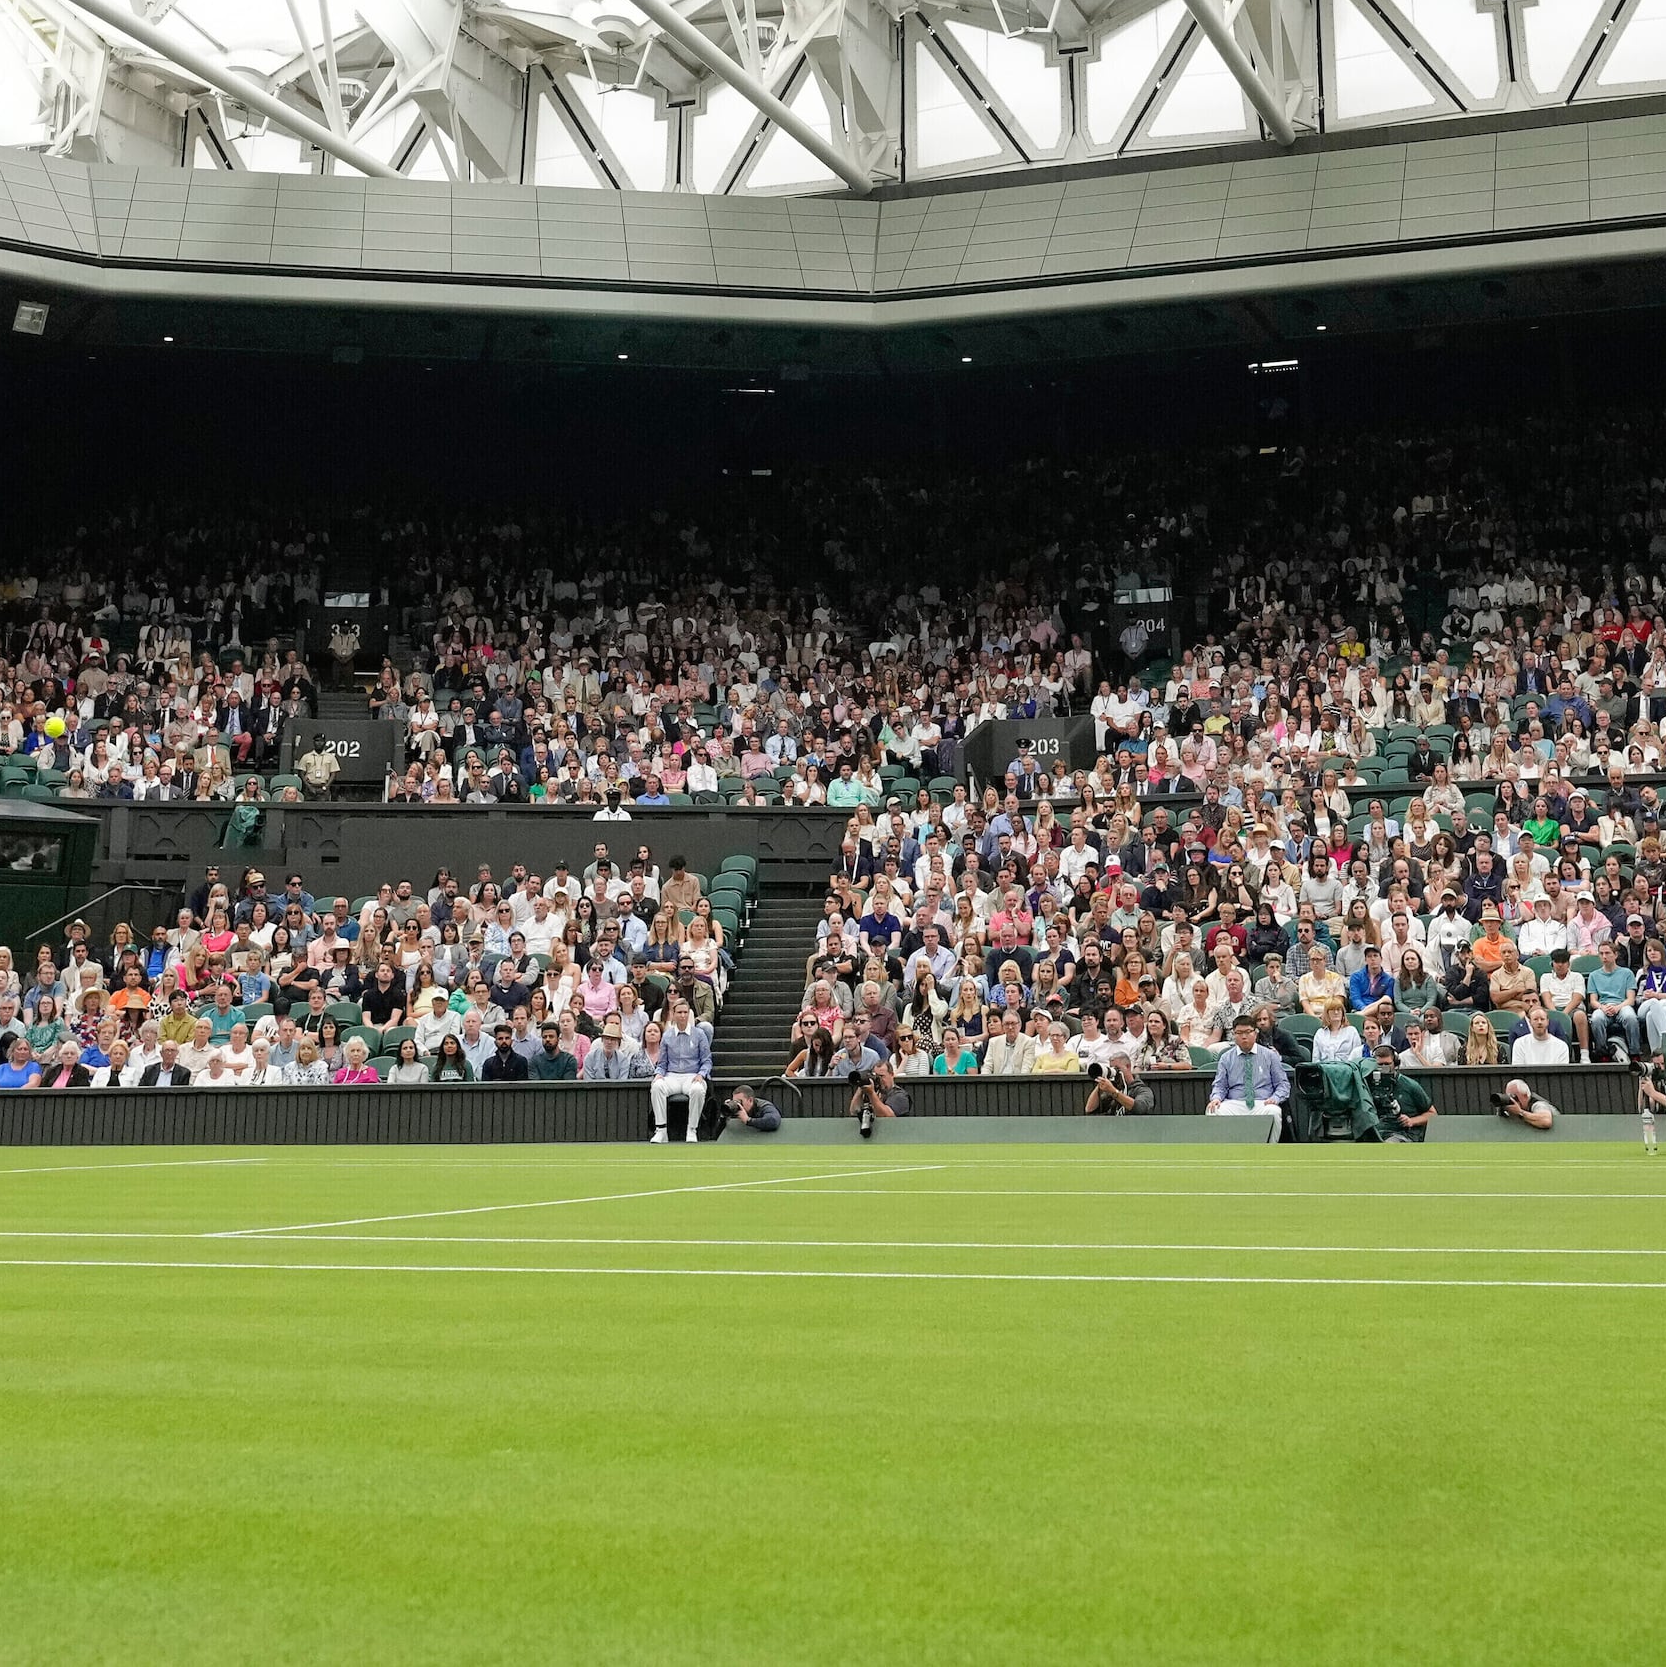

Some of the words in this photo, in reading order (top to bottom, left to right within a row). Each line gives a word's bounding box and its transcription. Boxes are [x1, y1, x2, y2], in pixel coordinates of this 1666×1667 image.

[331, 624, 361, 638] 33
[325, 740, 361, 758] 202
[1028, 738, 1059, 756] 203
